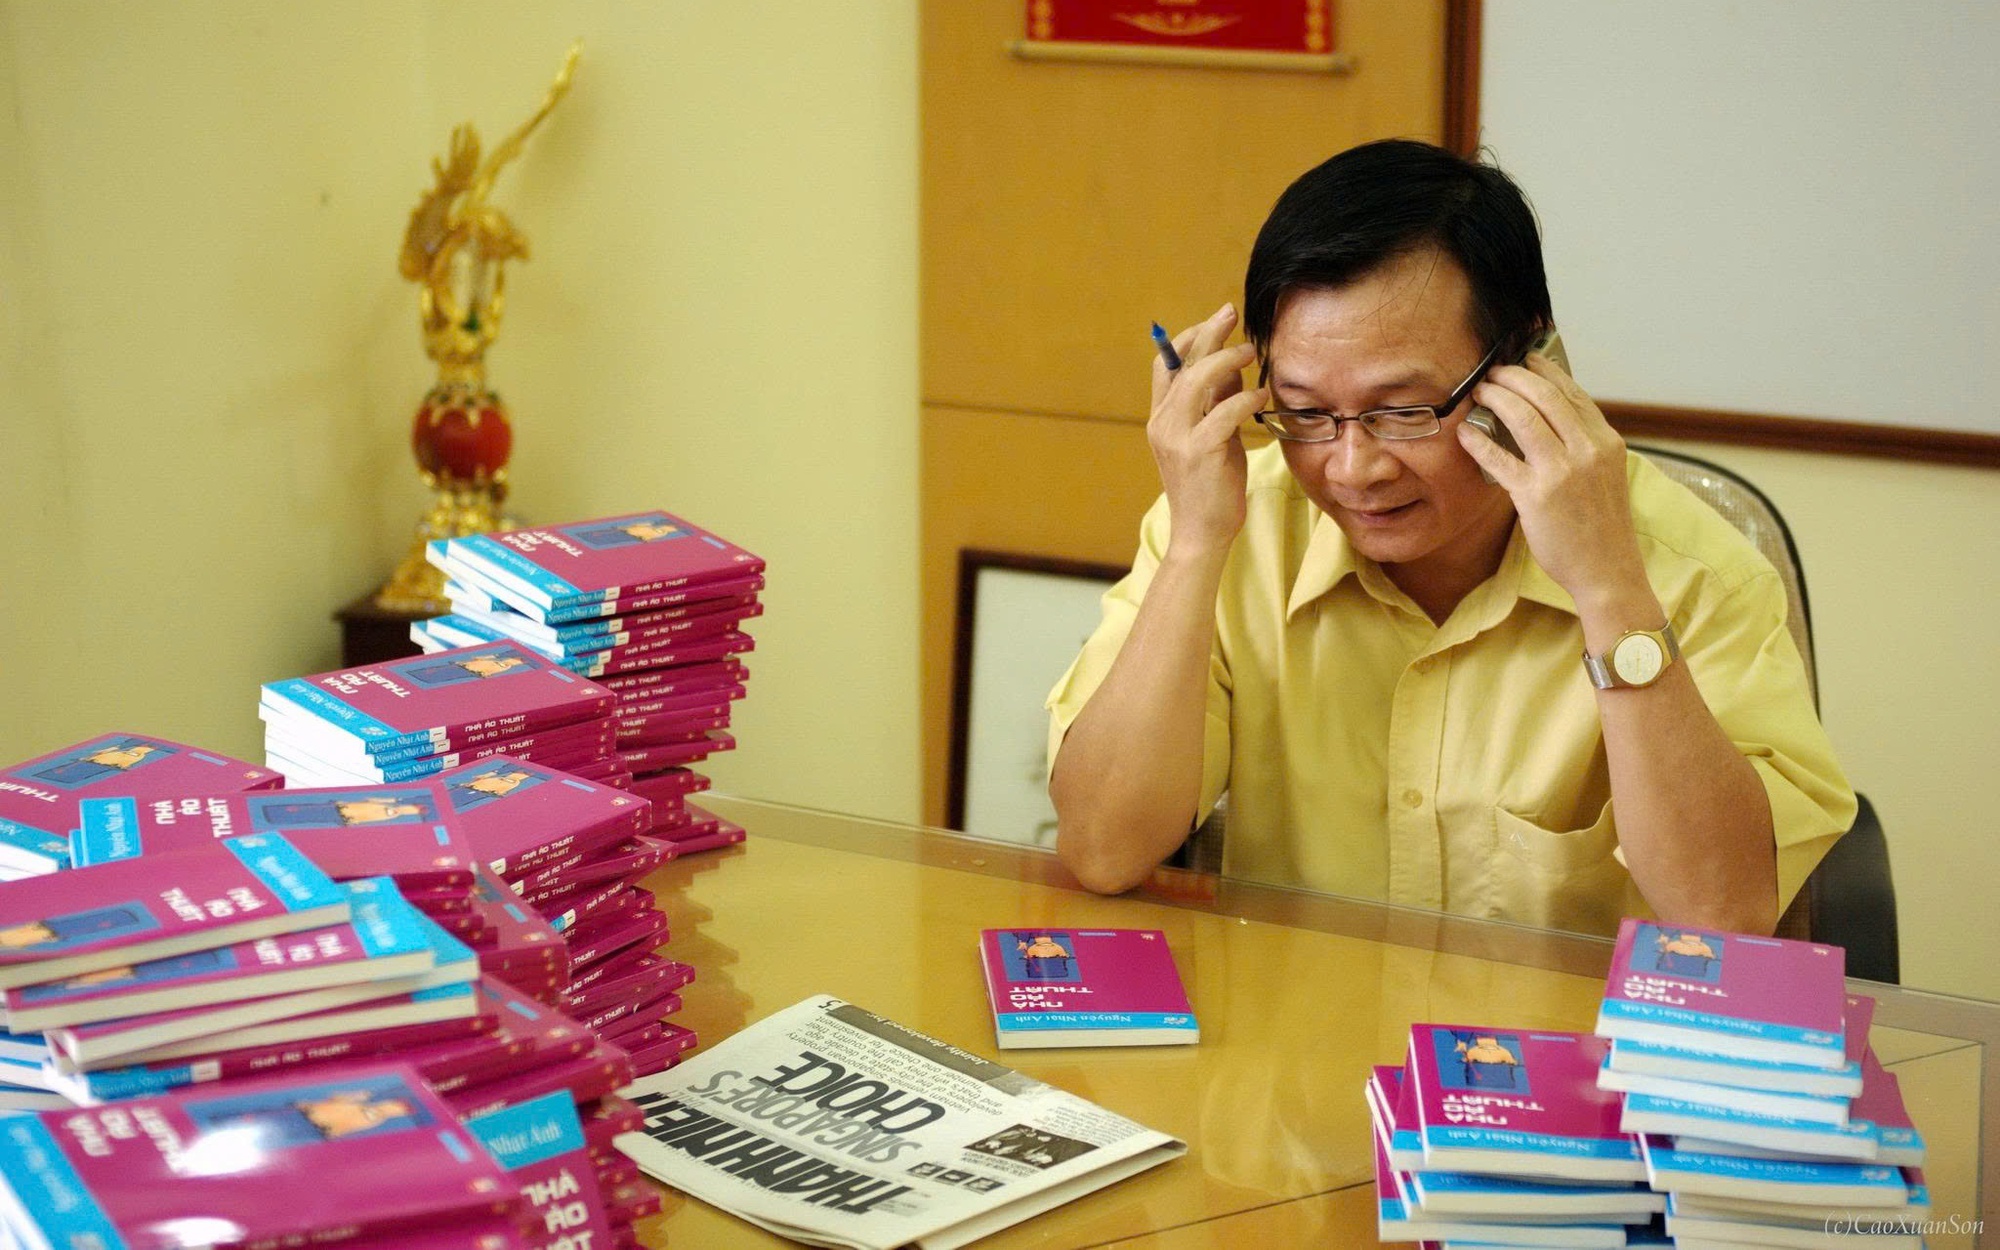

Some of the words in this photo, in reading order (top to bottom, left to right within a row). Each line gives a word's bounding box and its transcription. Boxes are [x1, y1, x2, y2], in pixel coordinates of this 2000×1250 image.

[805, 1021, 829, 1034] their
[816, 1016, 868, 1041] investment
[786, 1032, 827, 1052] property
[805, 1030, 824, 1041] ago
[825, 1040, 859, 1056] decade
[869, 1040, 884, 1049] for
[868, 1049, 885, 1059] the
[827, 1050, 888, 1079] Singaporean
[885, 1057, 904, 1066] call
[921, 1063, 941, 1073] one
[904, 1065, 928, 1077] they
[889, 1076, 928, 1095] reminds
[915, 1079, 933, 1089] the
[929, 1074, 951, 1086] why
[748, 1051, 946, 1134] CHOICE
[929, 1093, 971, 1114] Vietnam
[947, 1091, 1003, 1116] developers
[980, 1098, 1003, 1107] and
[686, 1070, 922, 1164] SINGAPORE'S
